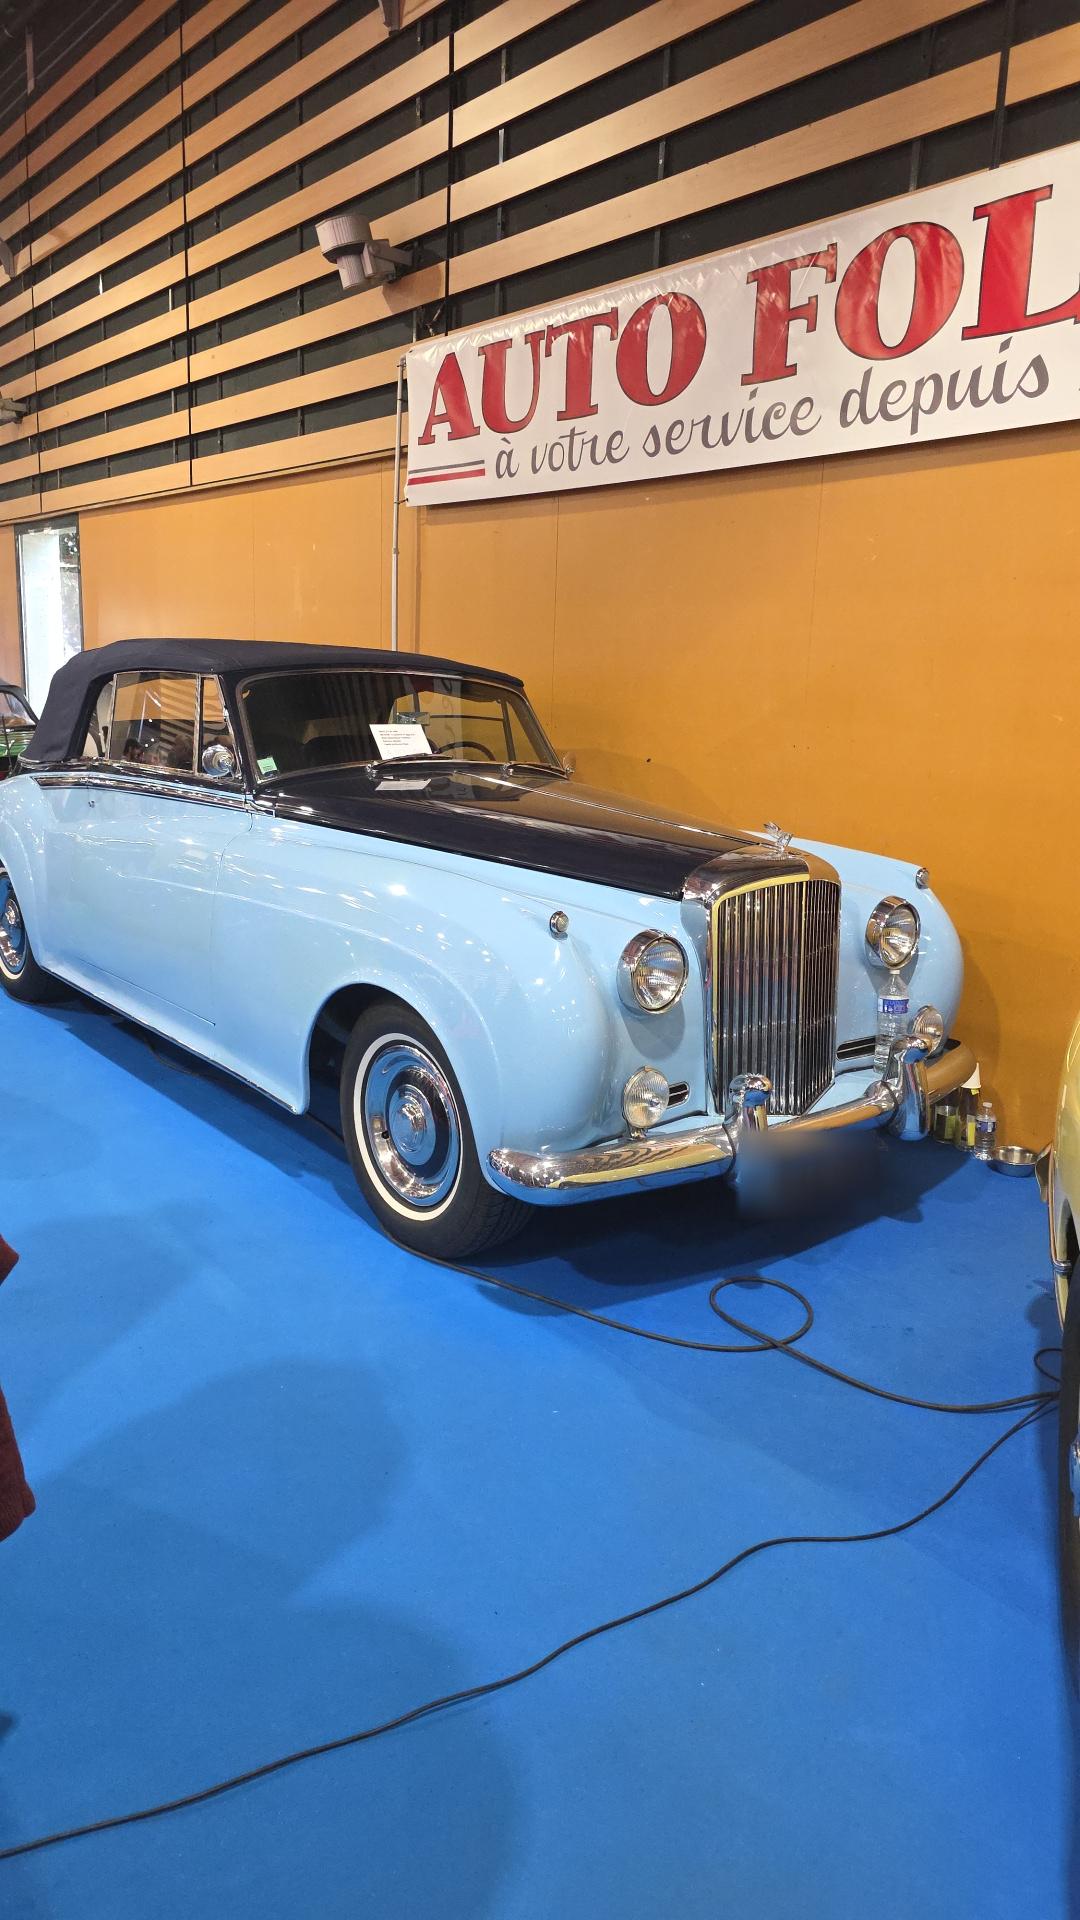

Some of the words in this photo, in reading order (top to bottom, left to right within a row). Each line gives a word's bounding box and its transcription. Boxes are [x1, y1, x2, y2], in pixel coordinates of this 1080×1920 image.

[418, 292, 707, 445] AUTO
[742, 185, 1080, 385] FOL
[495, 437, 520, 479] à
[531, 428, 630, 474] votre
[642, 388, 821, 457] service
[840, 337, 1050, 436] depuis
